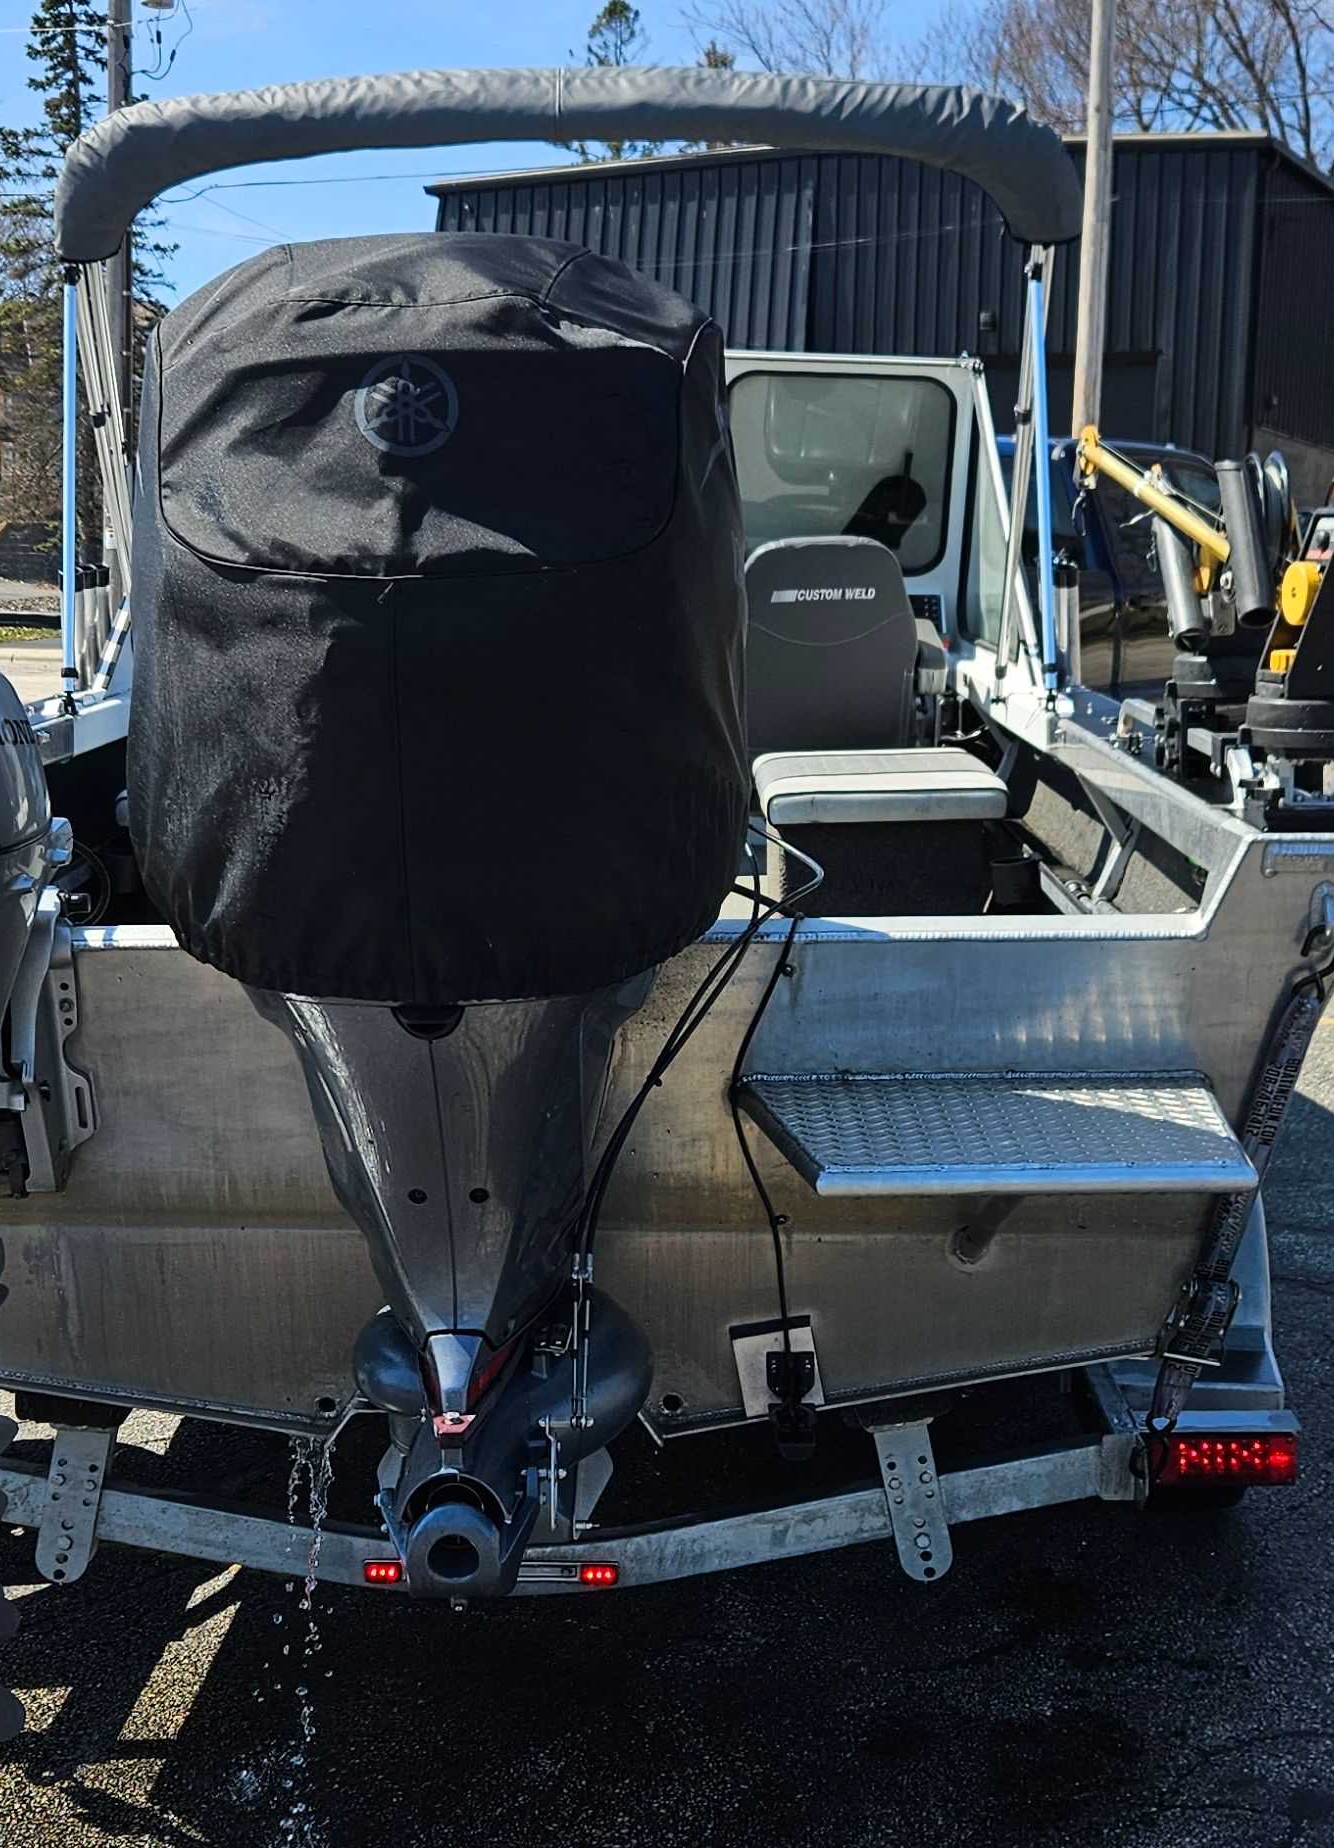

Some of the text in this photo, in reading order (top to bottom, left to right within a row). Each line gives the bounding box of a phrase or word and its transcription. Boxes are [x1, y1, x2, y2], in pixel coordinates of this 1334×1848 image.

[797, 587, 876, 601] CUSTOM WELD
[1246, 1062, 1283, 1138] 208-746-1412
[1258, 1058, 1301, 1147] BOATINGFUN.COM
